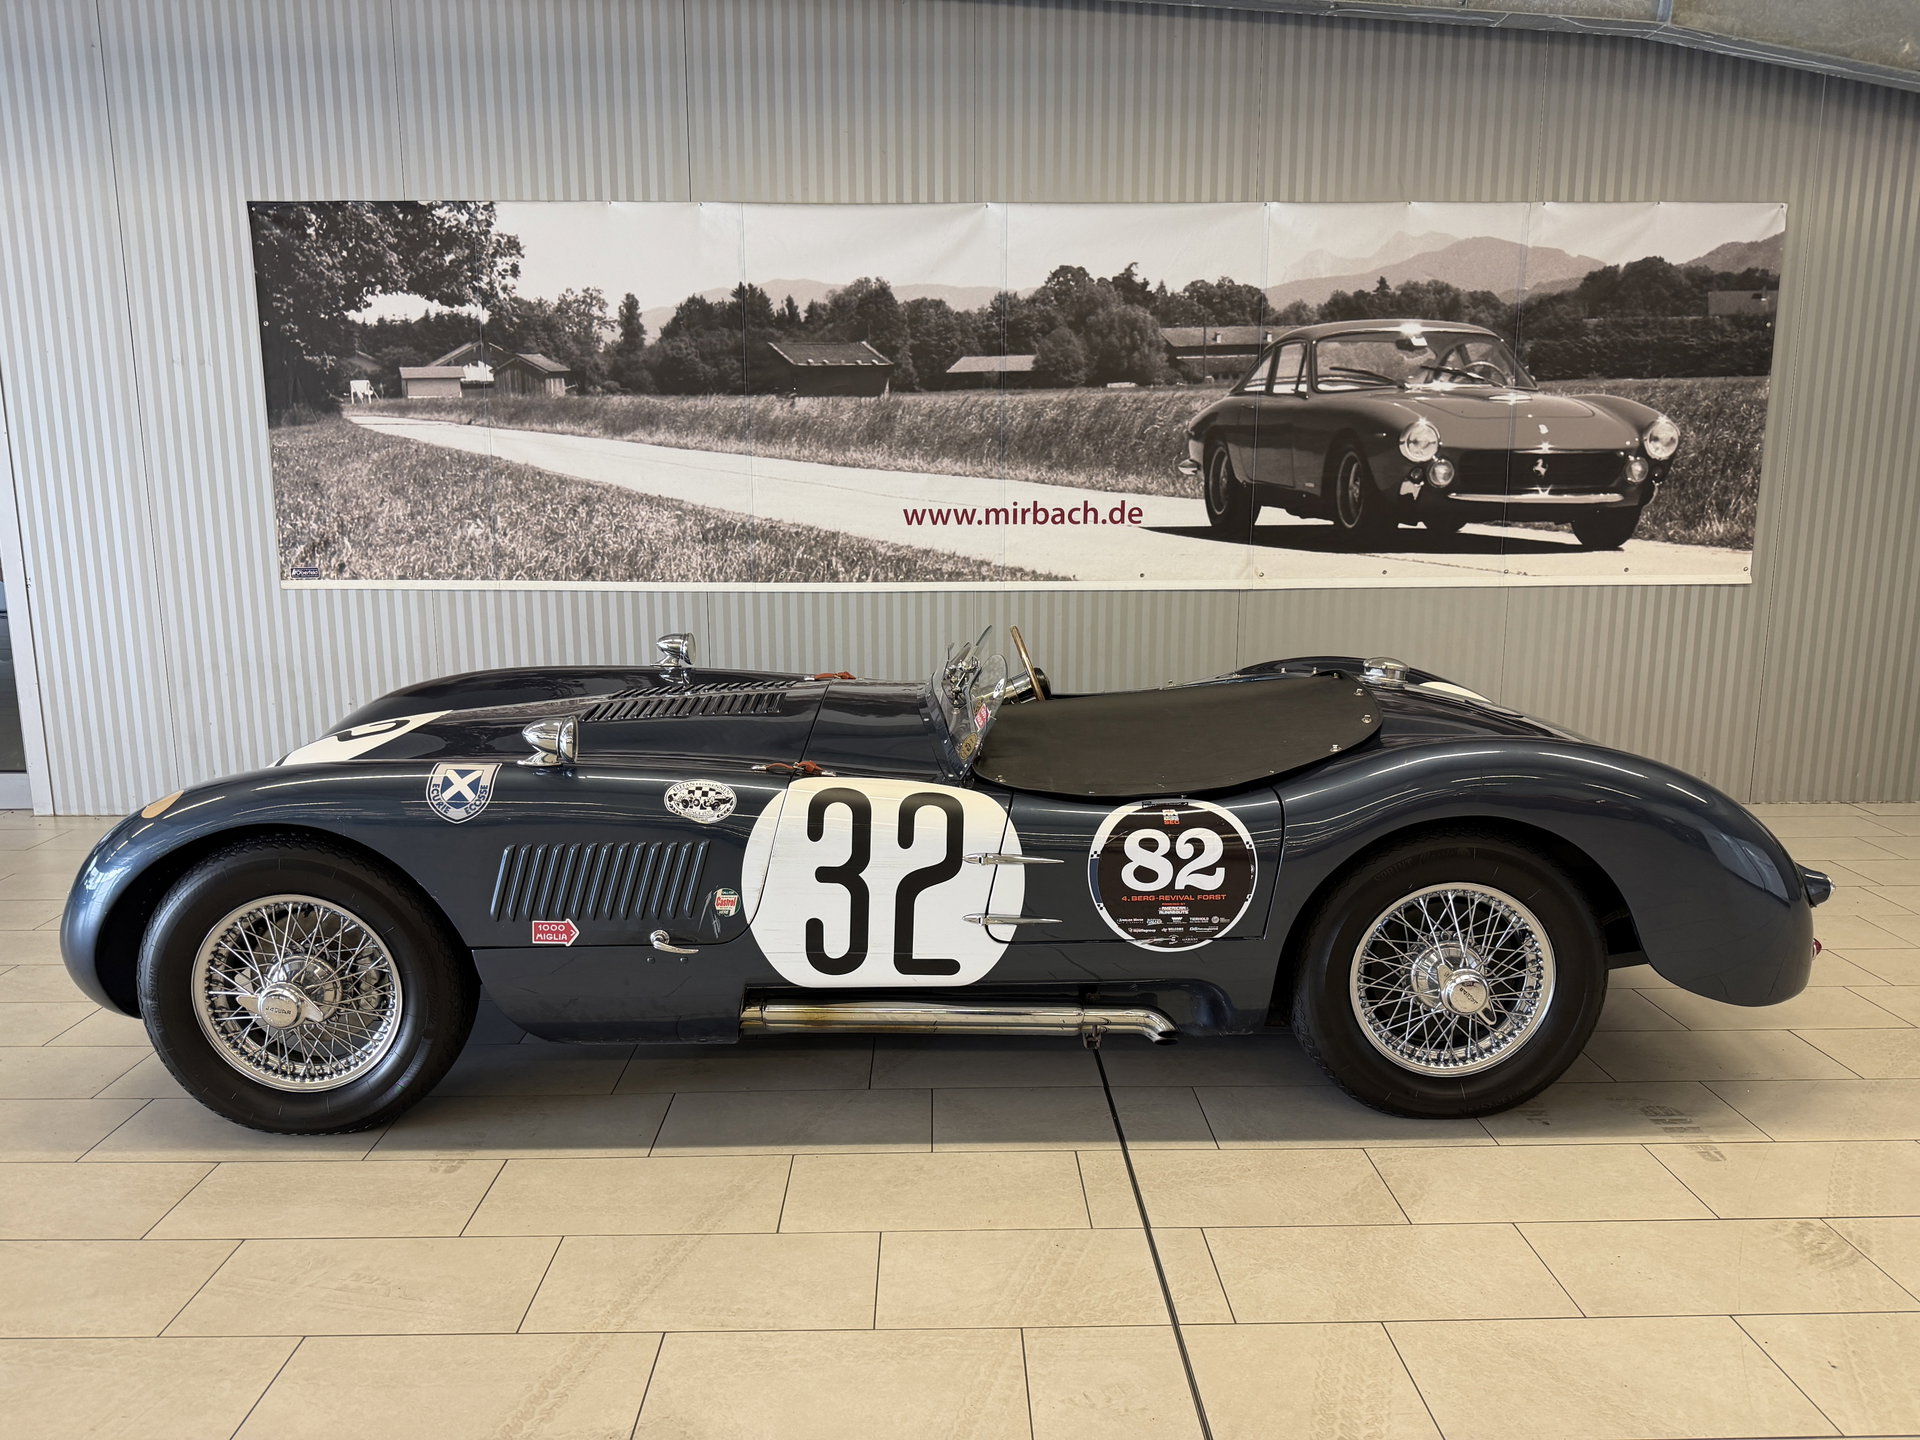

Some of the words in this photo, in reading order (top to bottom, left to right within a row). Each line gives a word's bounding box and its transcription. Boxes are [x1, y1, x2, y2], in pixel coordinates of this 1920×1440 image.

[903, 500, 1143, 526] www.mirbach.de
[431, 784, 451, 814] ECURIE
[464, 785, 489, 815] ECOSSE
[1121, 827, 1225, 892] 82
[806, 787, 964, 975] 32
[716, 896, 736, 907] Castrol
[1131, 894, 1195, 902] BERG-REVIVAL
[536, 933, 568, 941] MIGLIA
[1459, 987, 1479, 1005] JAGUAR
[265, 1006, 292, 1015] JAGUAR
